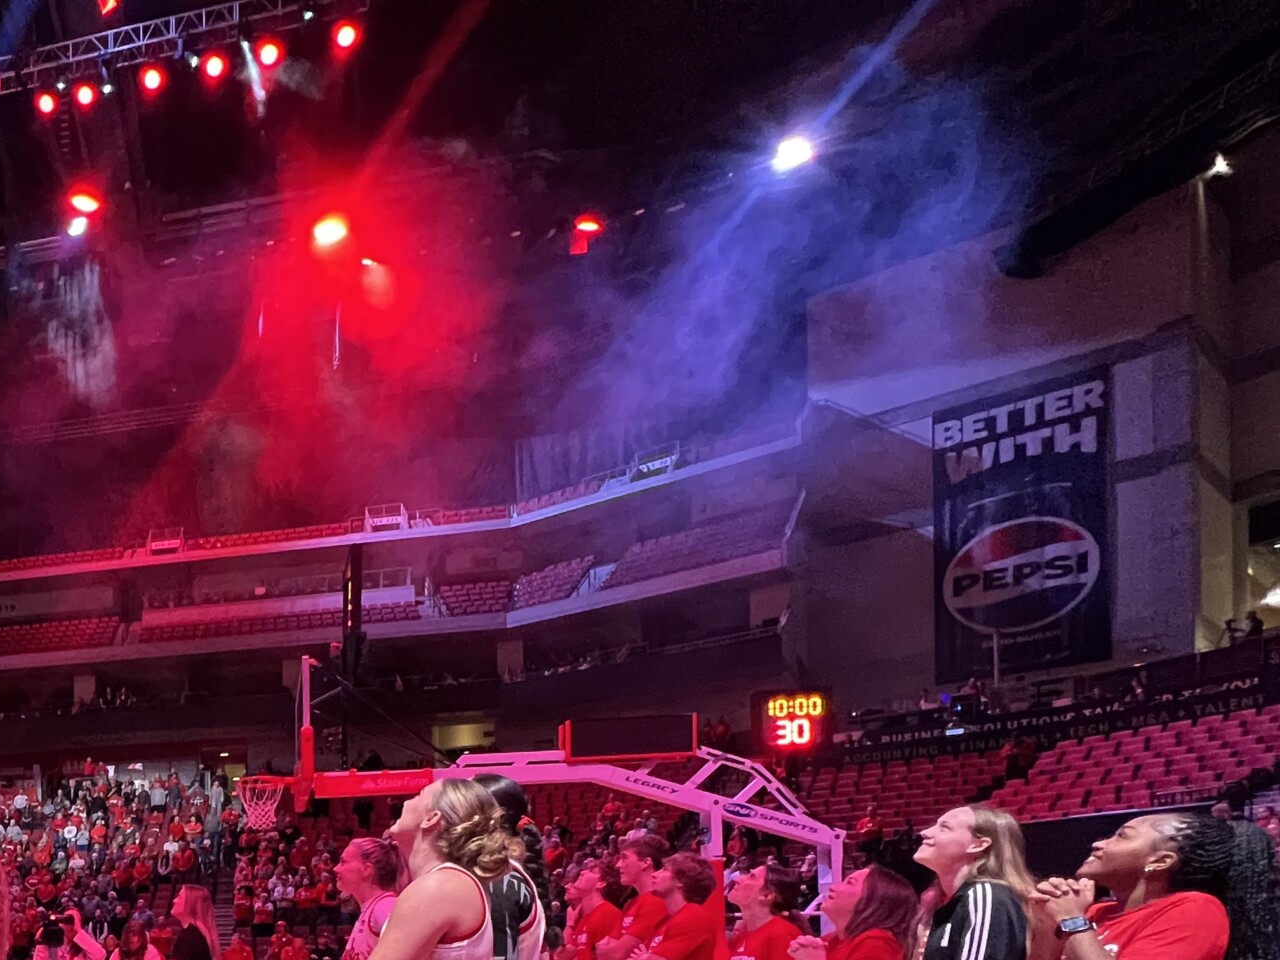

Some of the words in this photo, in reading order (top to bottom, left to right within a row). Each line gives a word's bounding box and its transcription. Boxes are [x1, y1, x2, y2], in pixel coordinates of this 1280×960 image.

[934, 380, 1105, 450] BETTER
[945, 415, 1098, 487] WITH
[952, 549, 1089, 598] PEPSI
[768, 697, 822, 717] 10:00
[1070, 721, 1109, 738] TECH
[1193, 693, 1265, 716] TALENT
[775, 718, 811, 745] 30
[625, 775, 680, 794] LEGACY
[757, 812, 819, 834] SPORTS
